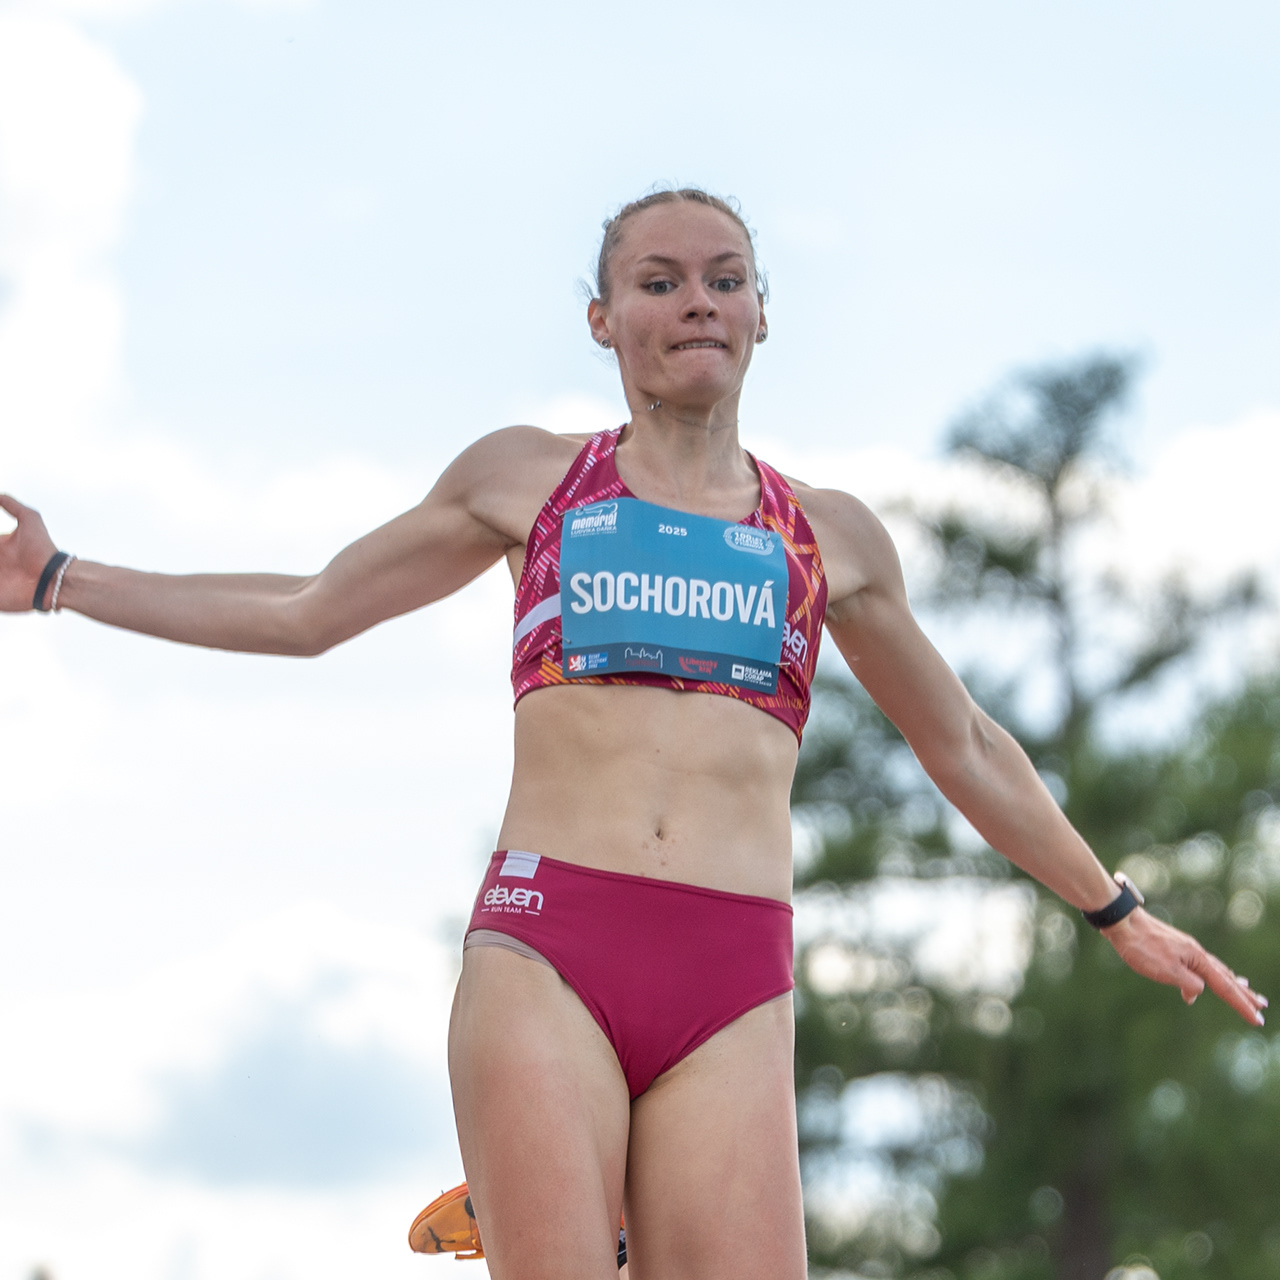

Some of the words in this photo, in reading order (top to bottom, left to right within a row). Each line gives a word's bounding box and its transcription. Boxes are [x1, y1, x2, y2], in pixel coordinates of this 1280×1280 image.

[658, 524, 688, 537] 2025
[570, 571, 776, 628] SOCHOROVÁ
[484, 884, 544, 910] eleven
[504, 906, 522, 914] TEAM
